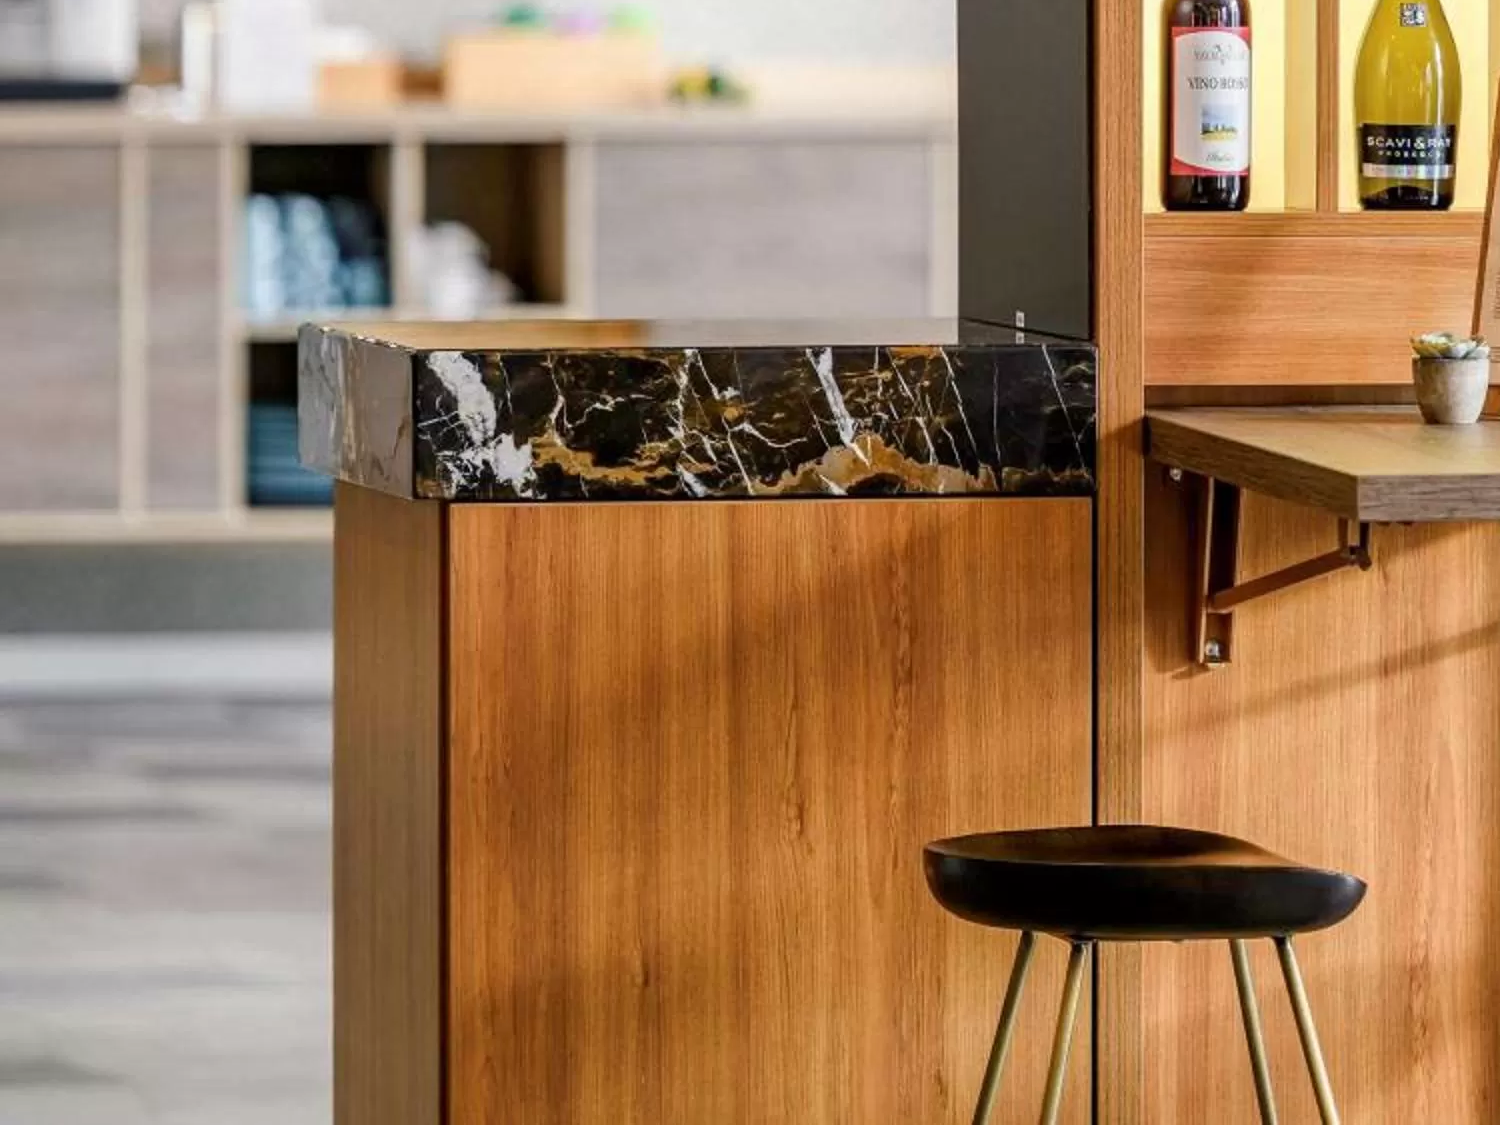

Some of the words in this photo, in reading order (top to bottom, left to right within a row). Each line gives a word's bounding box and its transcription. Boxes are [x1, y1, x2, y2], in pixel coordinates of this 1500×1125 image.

[1187, 76, 1218, 91] VINO
[1367, 137, 1411, 148] SCAVI
[1414, 136, 1425, 150] &
